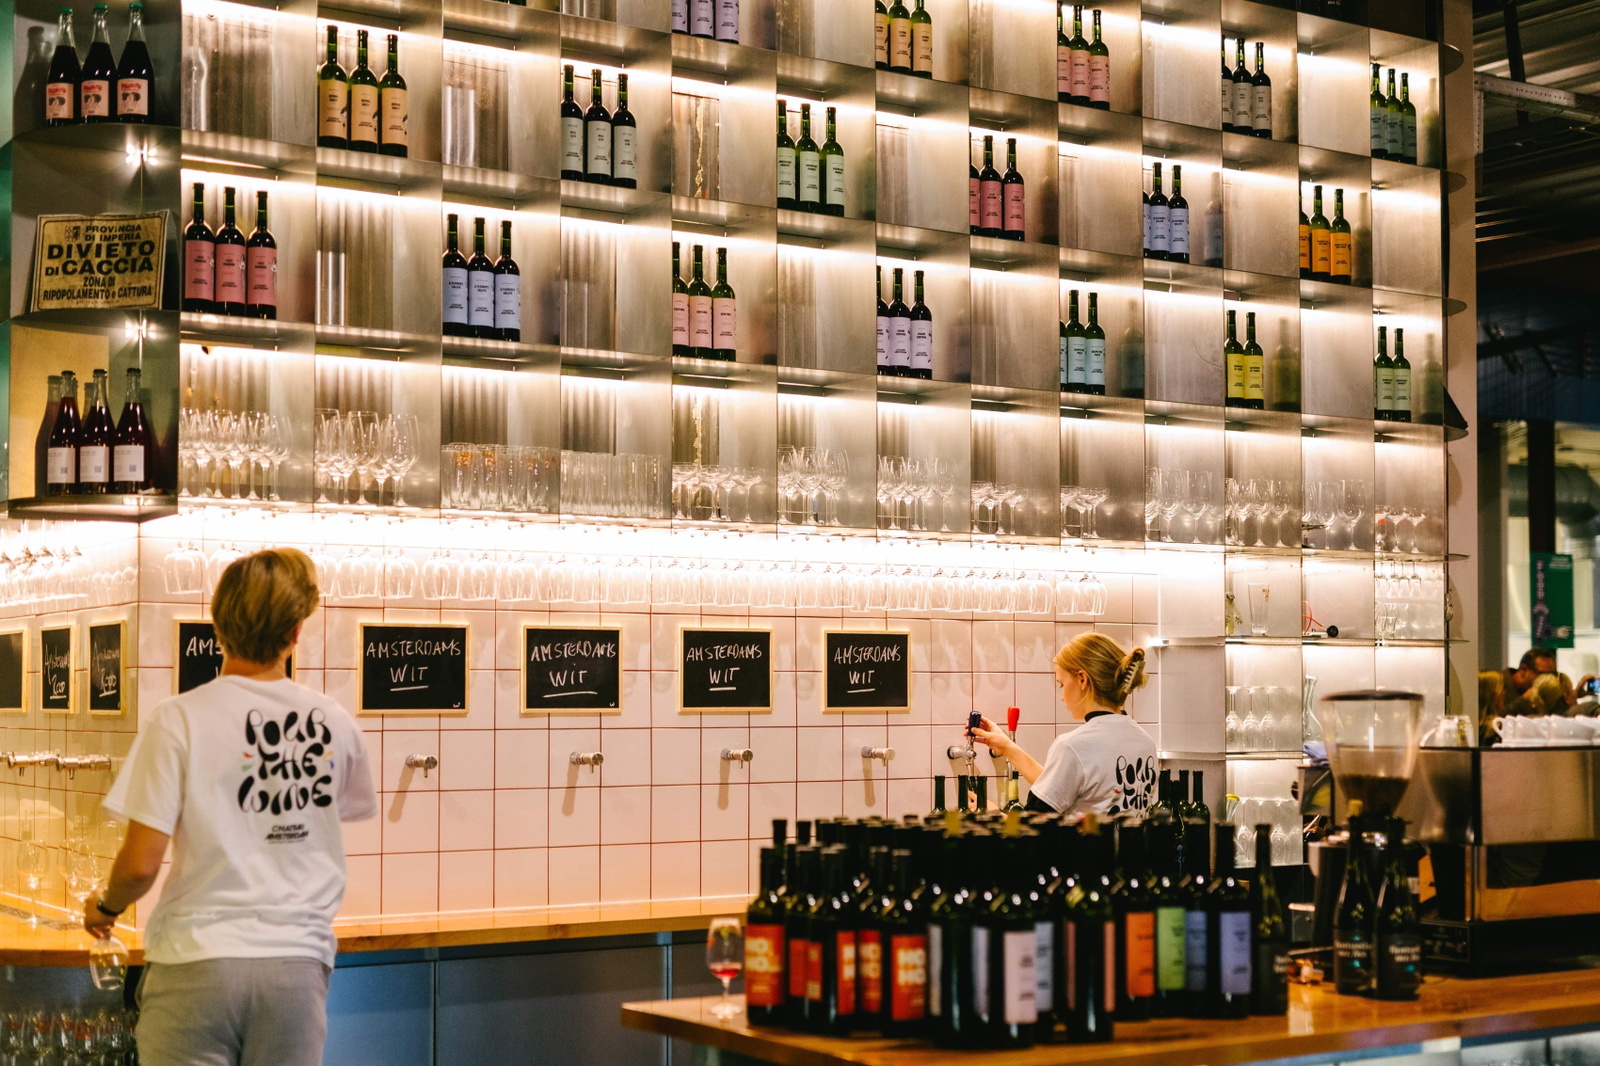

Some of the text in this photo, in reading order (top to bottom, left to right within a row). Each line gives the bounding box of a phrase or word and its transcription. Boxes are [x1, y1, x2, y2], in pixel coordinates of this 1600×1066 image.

[85, 224, 142, 233] PROVINCIA
[99, 233, 141, 242] IMPERIA
[47, 240, 155, 259] DIVIETO
[45, 257, 153, 276] DI CACCIA
[83, 276, 116, 288] ZONA DI
[43, 288, 110, 301] RIPOPOLAMENTO
[117, 286, 152, 299] CATTURA
[366, 639, 461, 659] AMSTERDAMS
[390, 663, 429, 683] WIT
[709, 667, 740, 684] WIT
[849, 670, 875, 685] WIT
[257, 742, 324, 780] THE
[238, 775, 332, 816] WINE
